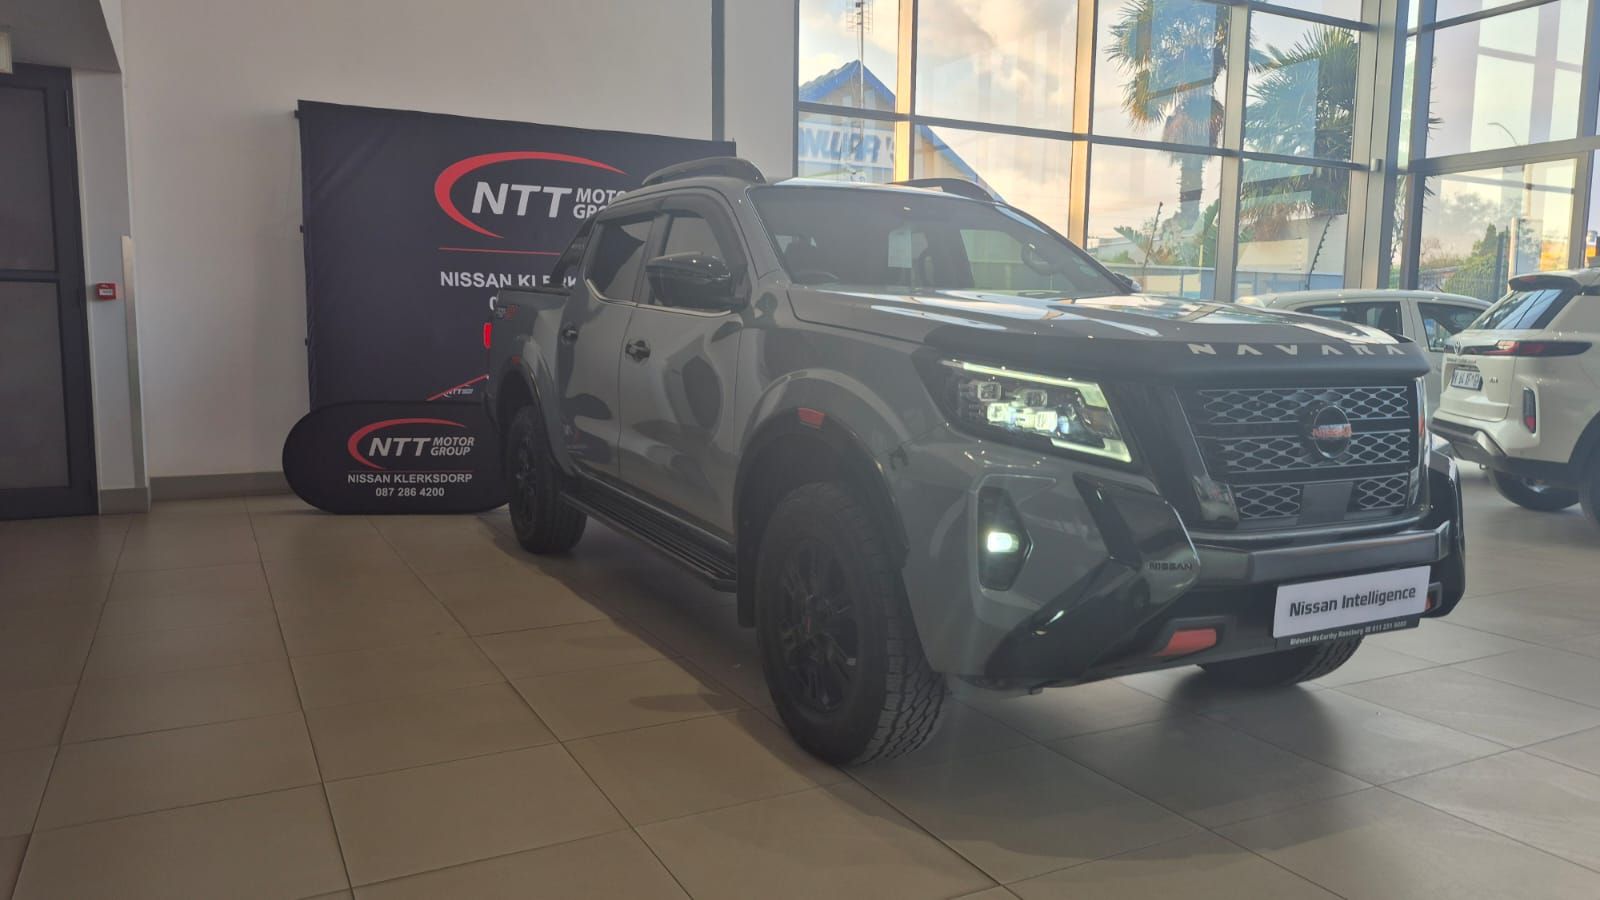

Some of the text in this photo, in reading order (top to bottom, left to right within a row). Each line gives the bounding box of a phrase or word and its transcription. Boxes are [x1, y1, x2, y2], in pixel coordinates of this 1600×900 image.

[472, 181, 572, 218] NTT
[440, 271, 512, 288] NISSAN
[1187, 343, 1406, 356] NAVARA
[368, 437, 431, 457] NTT
[432, 436, 475, 447] MOTOR
[430, 446, 471, 456] GROUP
[347, 473, 473, 484] NISSAN KLERKSDORP
[375, 487, 445, 497] 087 286 4200
[1149, 561, 1193, 571] NISSAN
[1289, 586, 1416, 617] Nissan Intelligence
